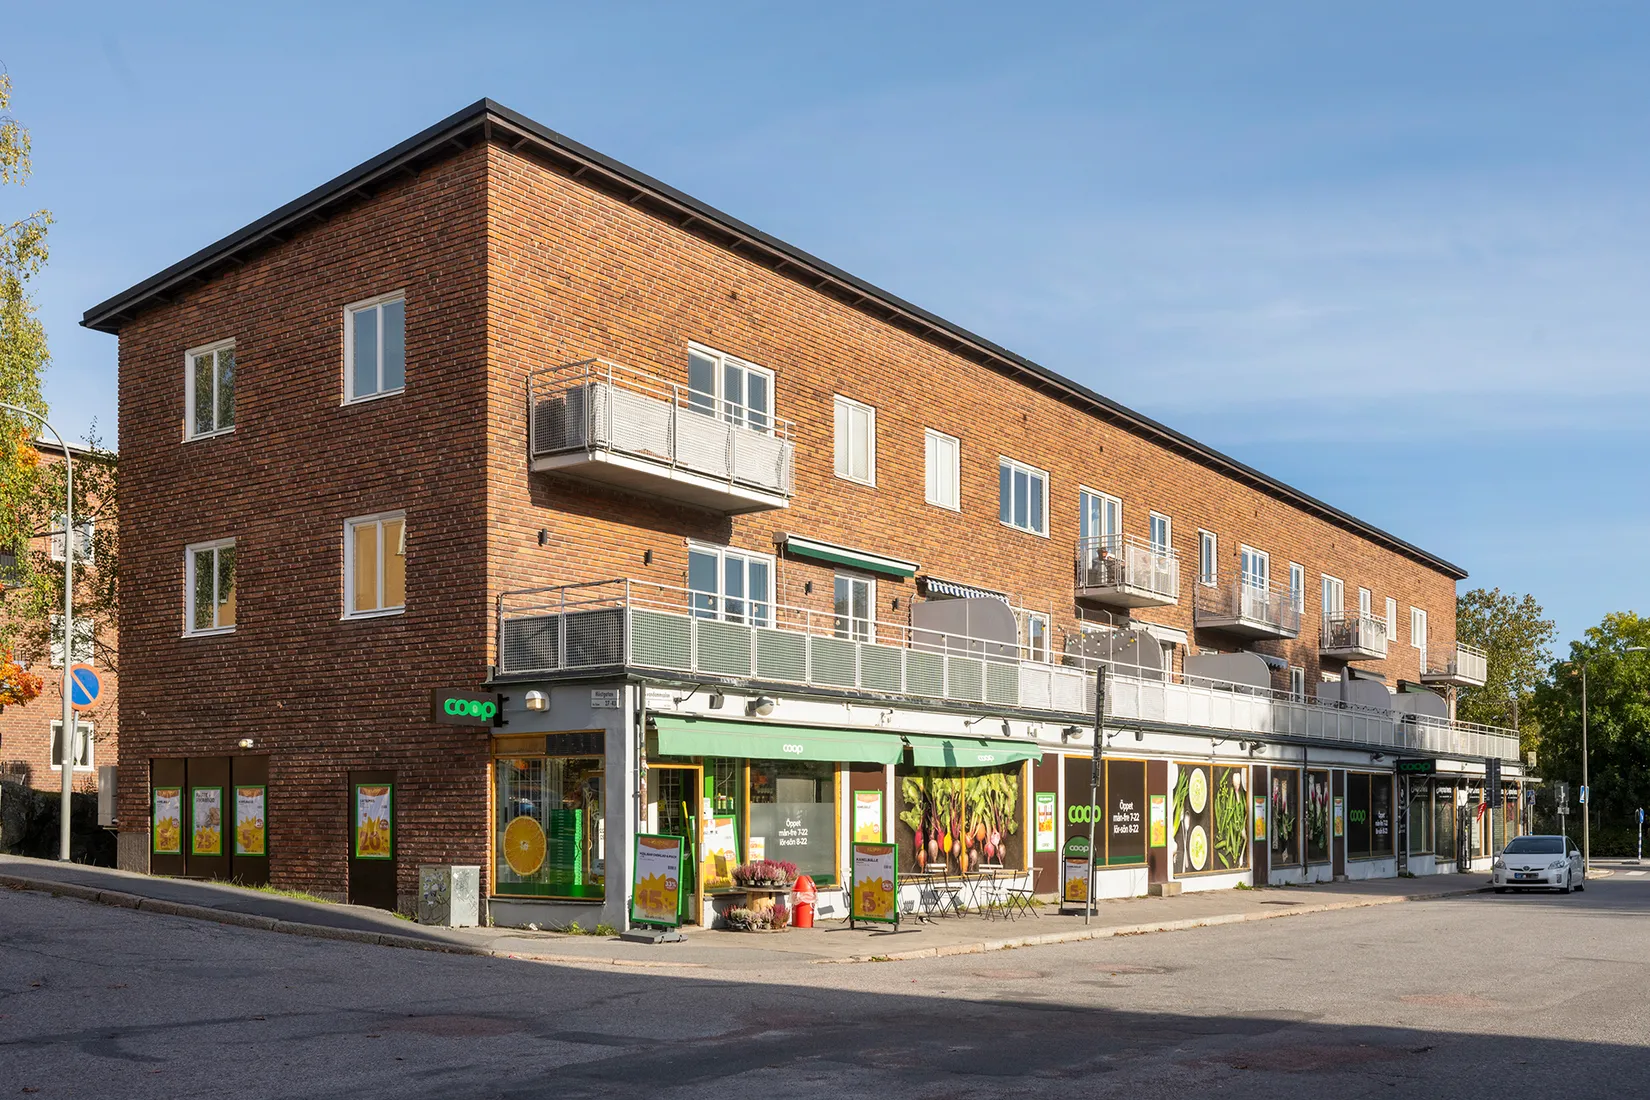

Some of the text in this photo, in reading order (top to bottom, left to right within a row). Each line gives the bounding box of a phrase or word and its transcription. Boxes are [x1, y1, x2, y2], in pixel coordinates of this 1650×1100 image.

[444, 698, 497, 721] coop
[783, 744, 803, 755] coop
[978, 754, 995, 762] coop
[1400, 762, 1431, 772] coop
[1119, 799, 1134, 812] Öppet
[1350, 809, 1366, 824] coop
[785, 818, 801, 828] Öppet
[1069, 845, 1089, 853] coop
